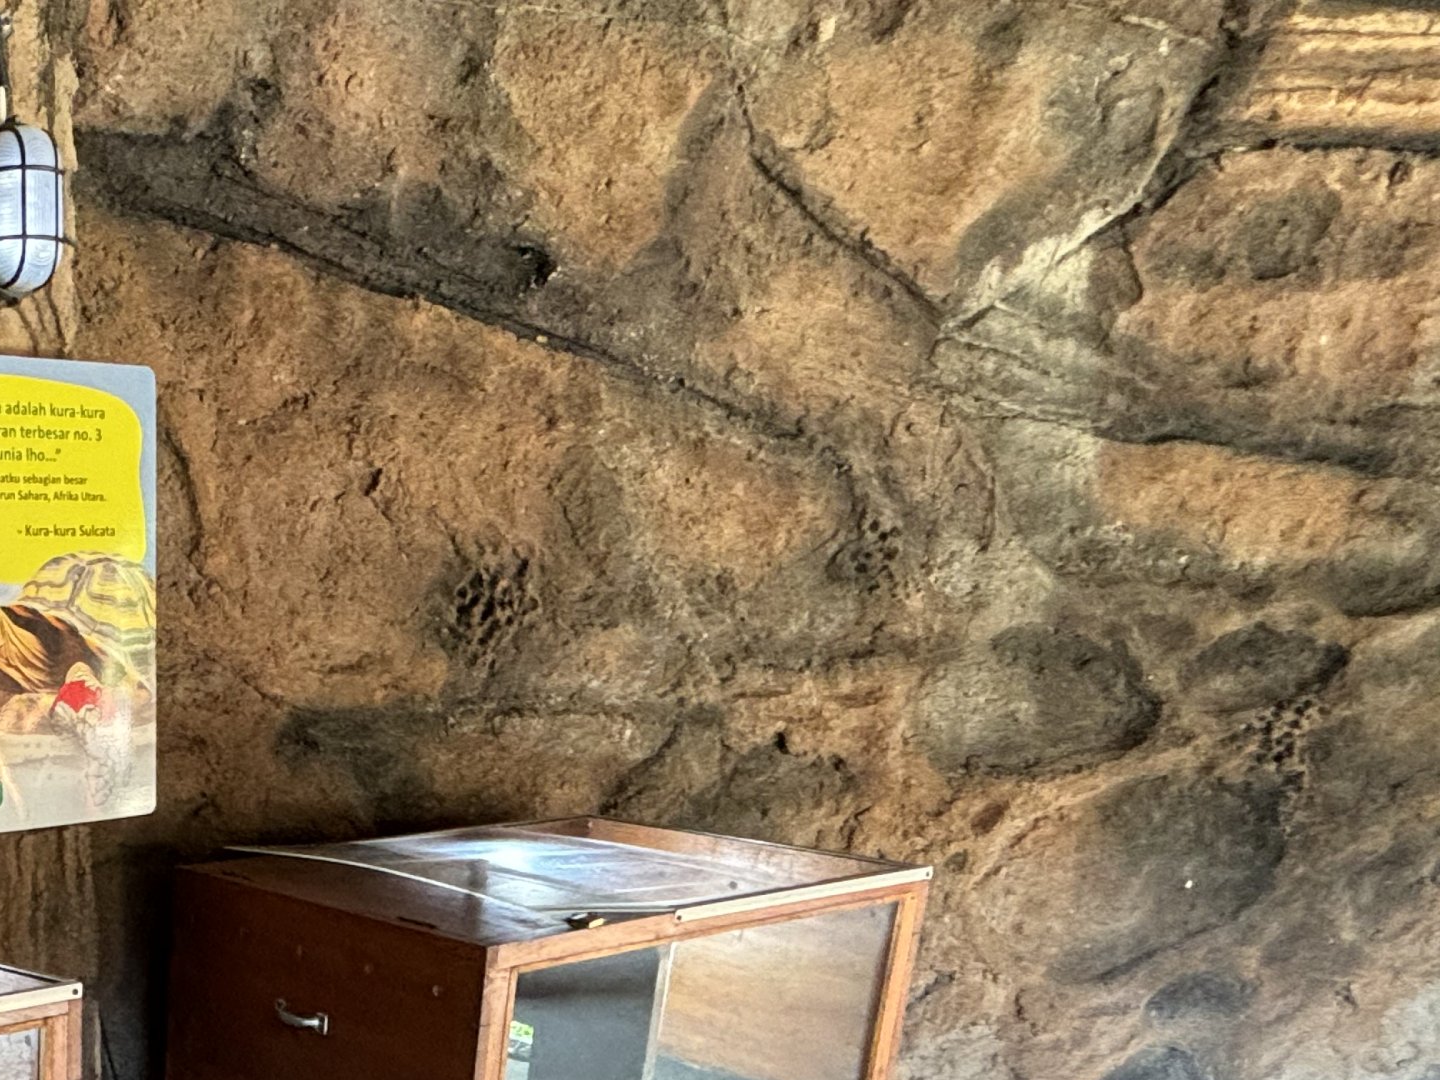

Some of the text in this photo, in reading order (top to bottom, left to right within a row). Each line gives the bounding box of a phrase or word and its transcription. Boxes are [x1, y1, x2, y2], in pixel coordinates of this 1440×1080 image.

[6, 400, 45, 416] adalah
[50, 401, 105, 420] kura-kura
[20, 426, 70, 440] terbesar
[73, 430, 92, 441] no.
[95, 428, 102, 441] 3
[23, 473, 61, 487] sebagian
[64, 475, 87, 485] besar
[18, 490, 50, 502] Sahara,
[53, 491, 78, 502] Afrika
[81, 492, 107, 502] Utara.
[25, 524, 76, 537] Kura-kura
[79, 523, 115, 536] Sulcata
